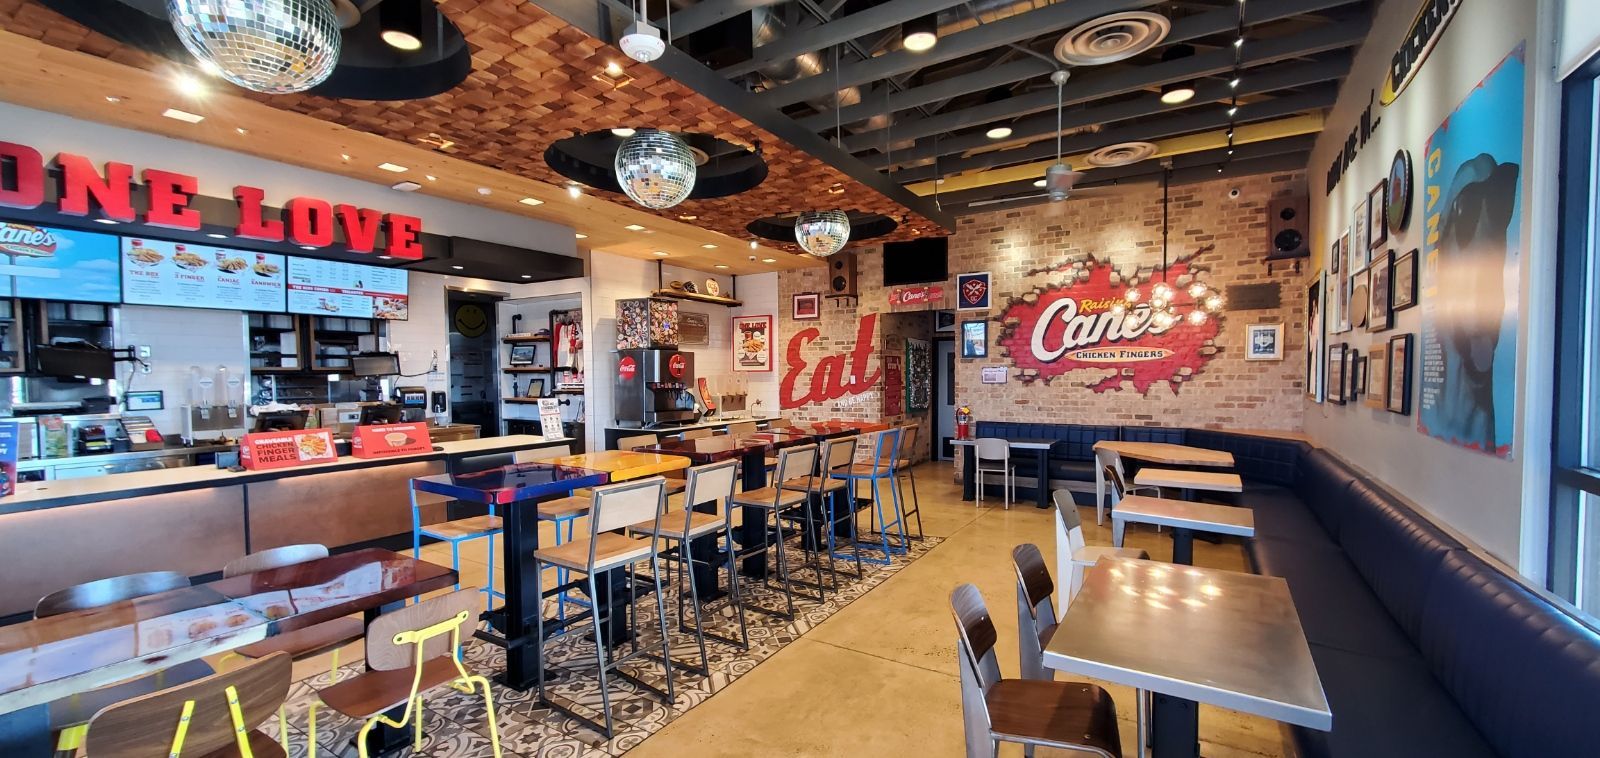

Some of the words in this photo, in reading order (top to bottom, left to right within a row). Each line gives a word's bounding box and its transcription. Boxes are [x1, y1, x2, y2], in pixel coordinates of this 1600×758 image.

[1424, 148, 1441, 273] CANE
[233, 185, 423, 260] LOVE
[0, 221, 56, 247] ane's
[902, 291, 925, 303] Cane's
[1031, 297, 1183, 363] Canes
[779, 313, 881, 410] Eat
[1075, 351, 1116, 359] CHICKEN
[1119, 350, 1164, 358] FINGERS
[256, 442, 294, 450] CHICKEN
[257, 447, 295, 456] FINGER
[258, 453, 297, 463] MEALS
